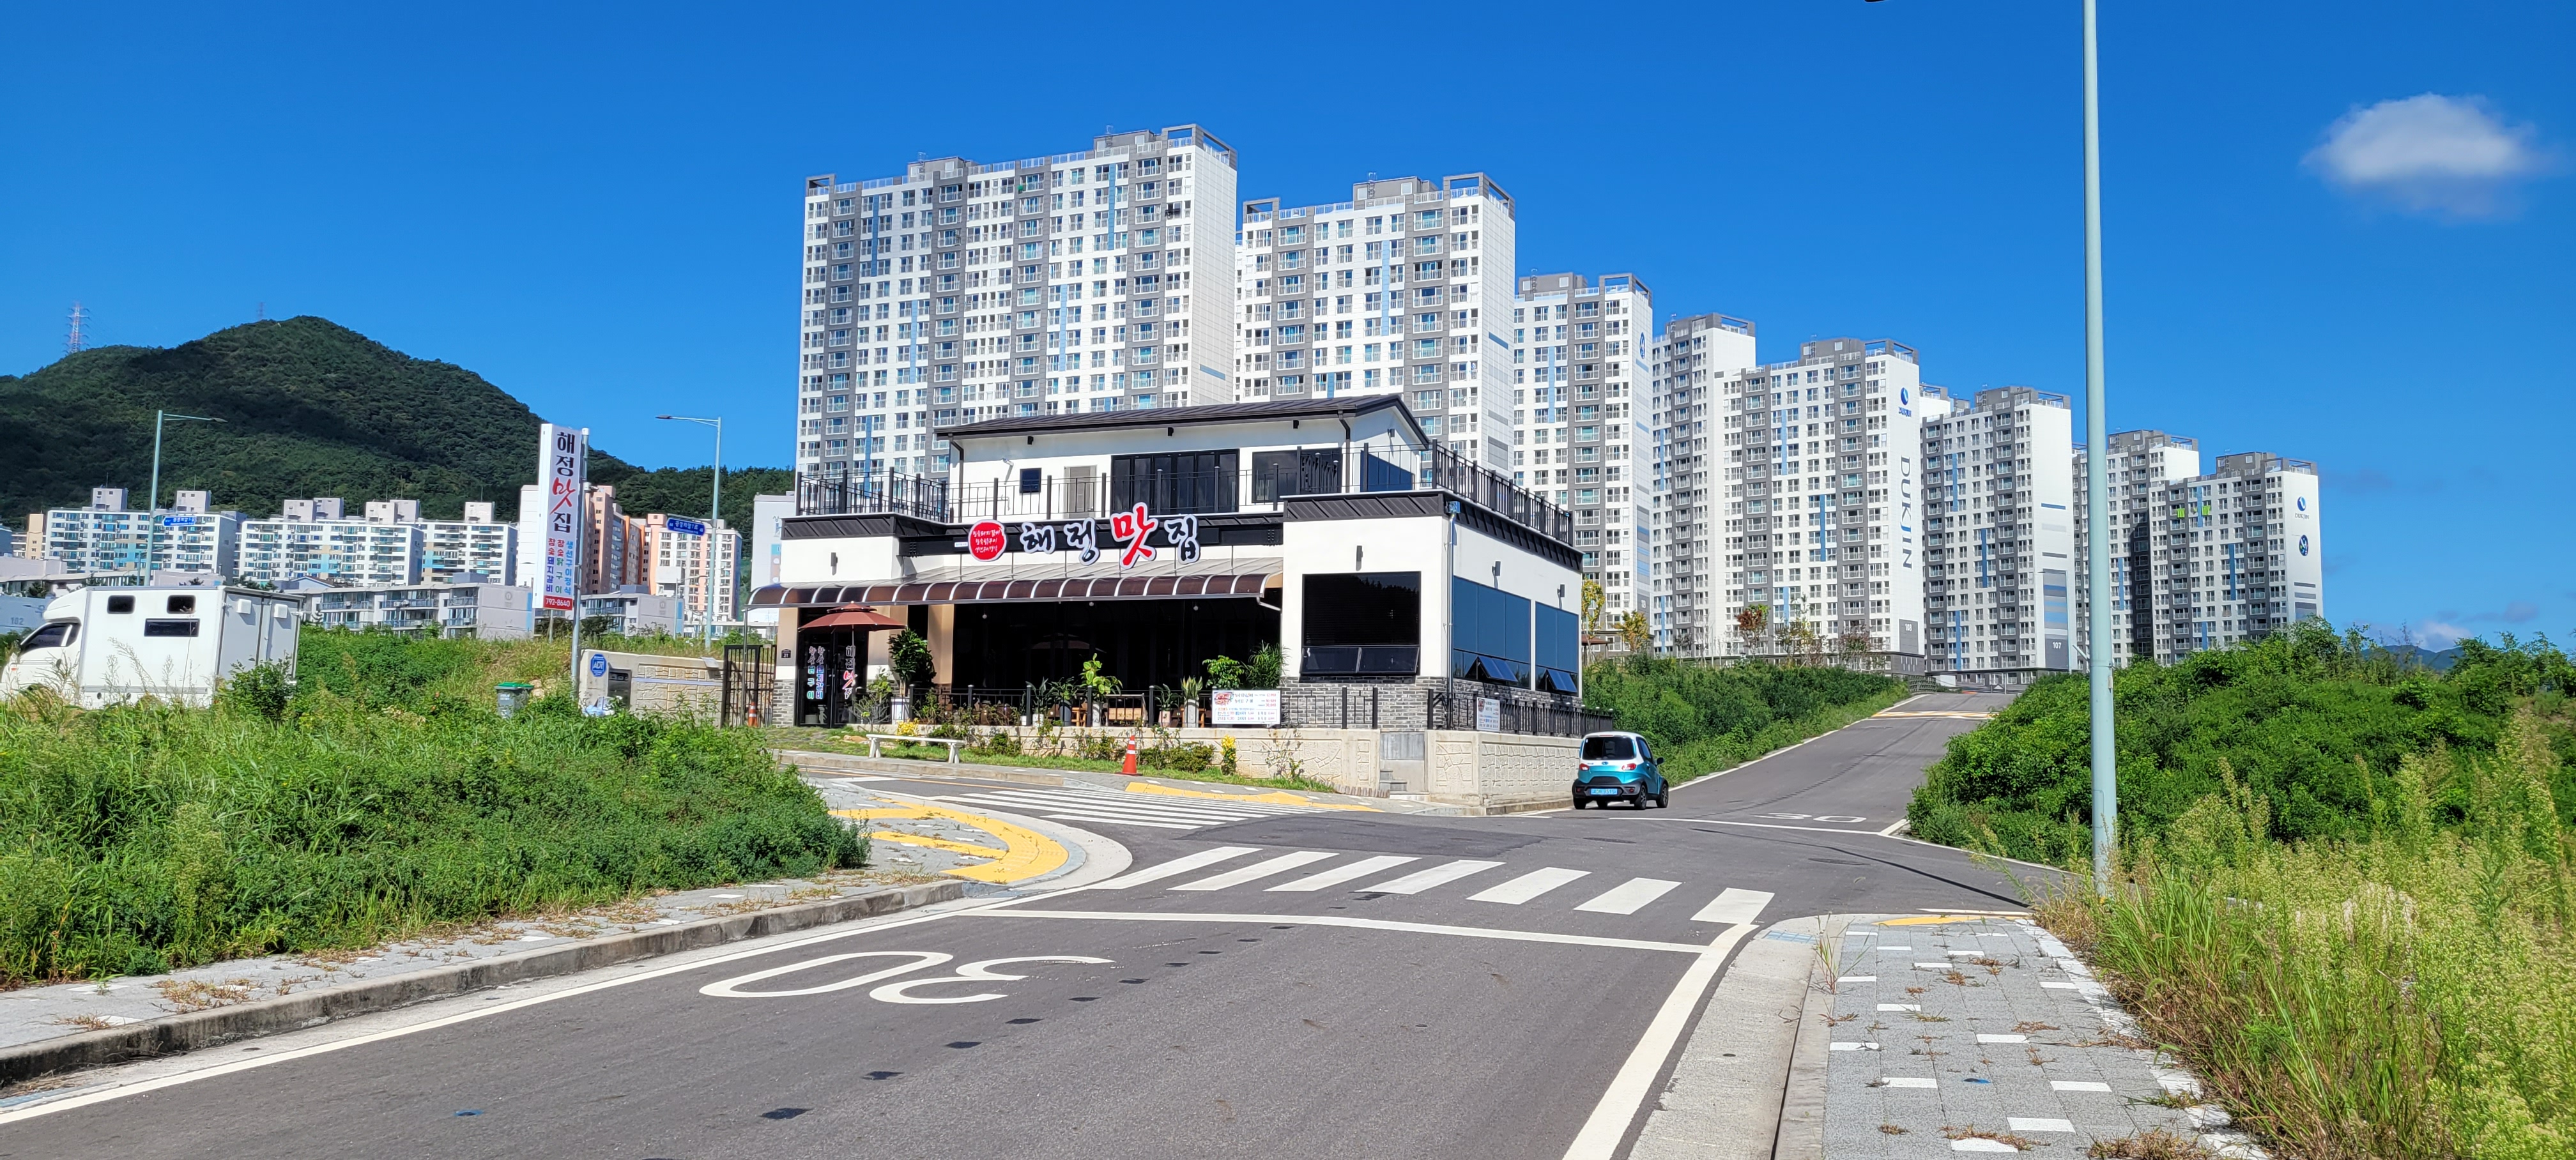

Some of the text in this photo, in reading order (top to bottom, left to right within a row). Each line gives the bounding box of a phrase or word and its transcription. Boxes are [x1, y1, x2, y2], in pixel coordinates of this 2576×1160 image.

[550, 431, 576, 533] 해정맛집
[1022, 505, 1197, 567] 해정맛집
[1900, 455, 1912, 570] DUKJIN
[546, 538, 555, 593] 참숯돼지갈비
[564, 540, 574, 595] 생선구이정식
[546, 598, 571, 607] 792-8640
[593, 661, 604, 669] ADT
[1749, 813, 1867, 823] 30
[699, 951, 1116, 1004] 30
